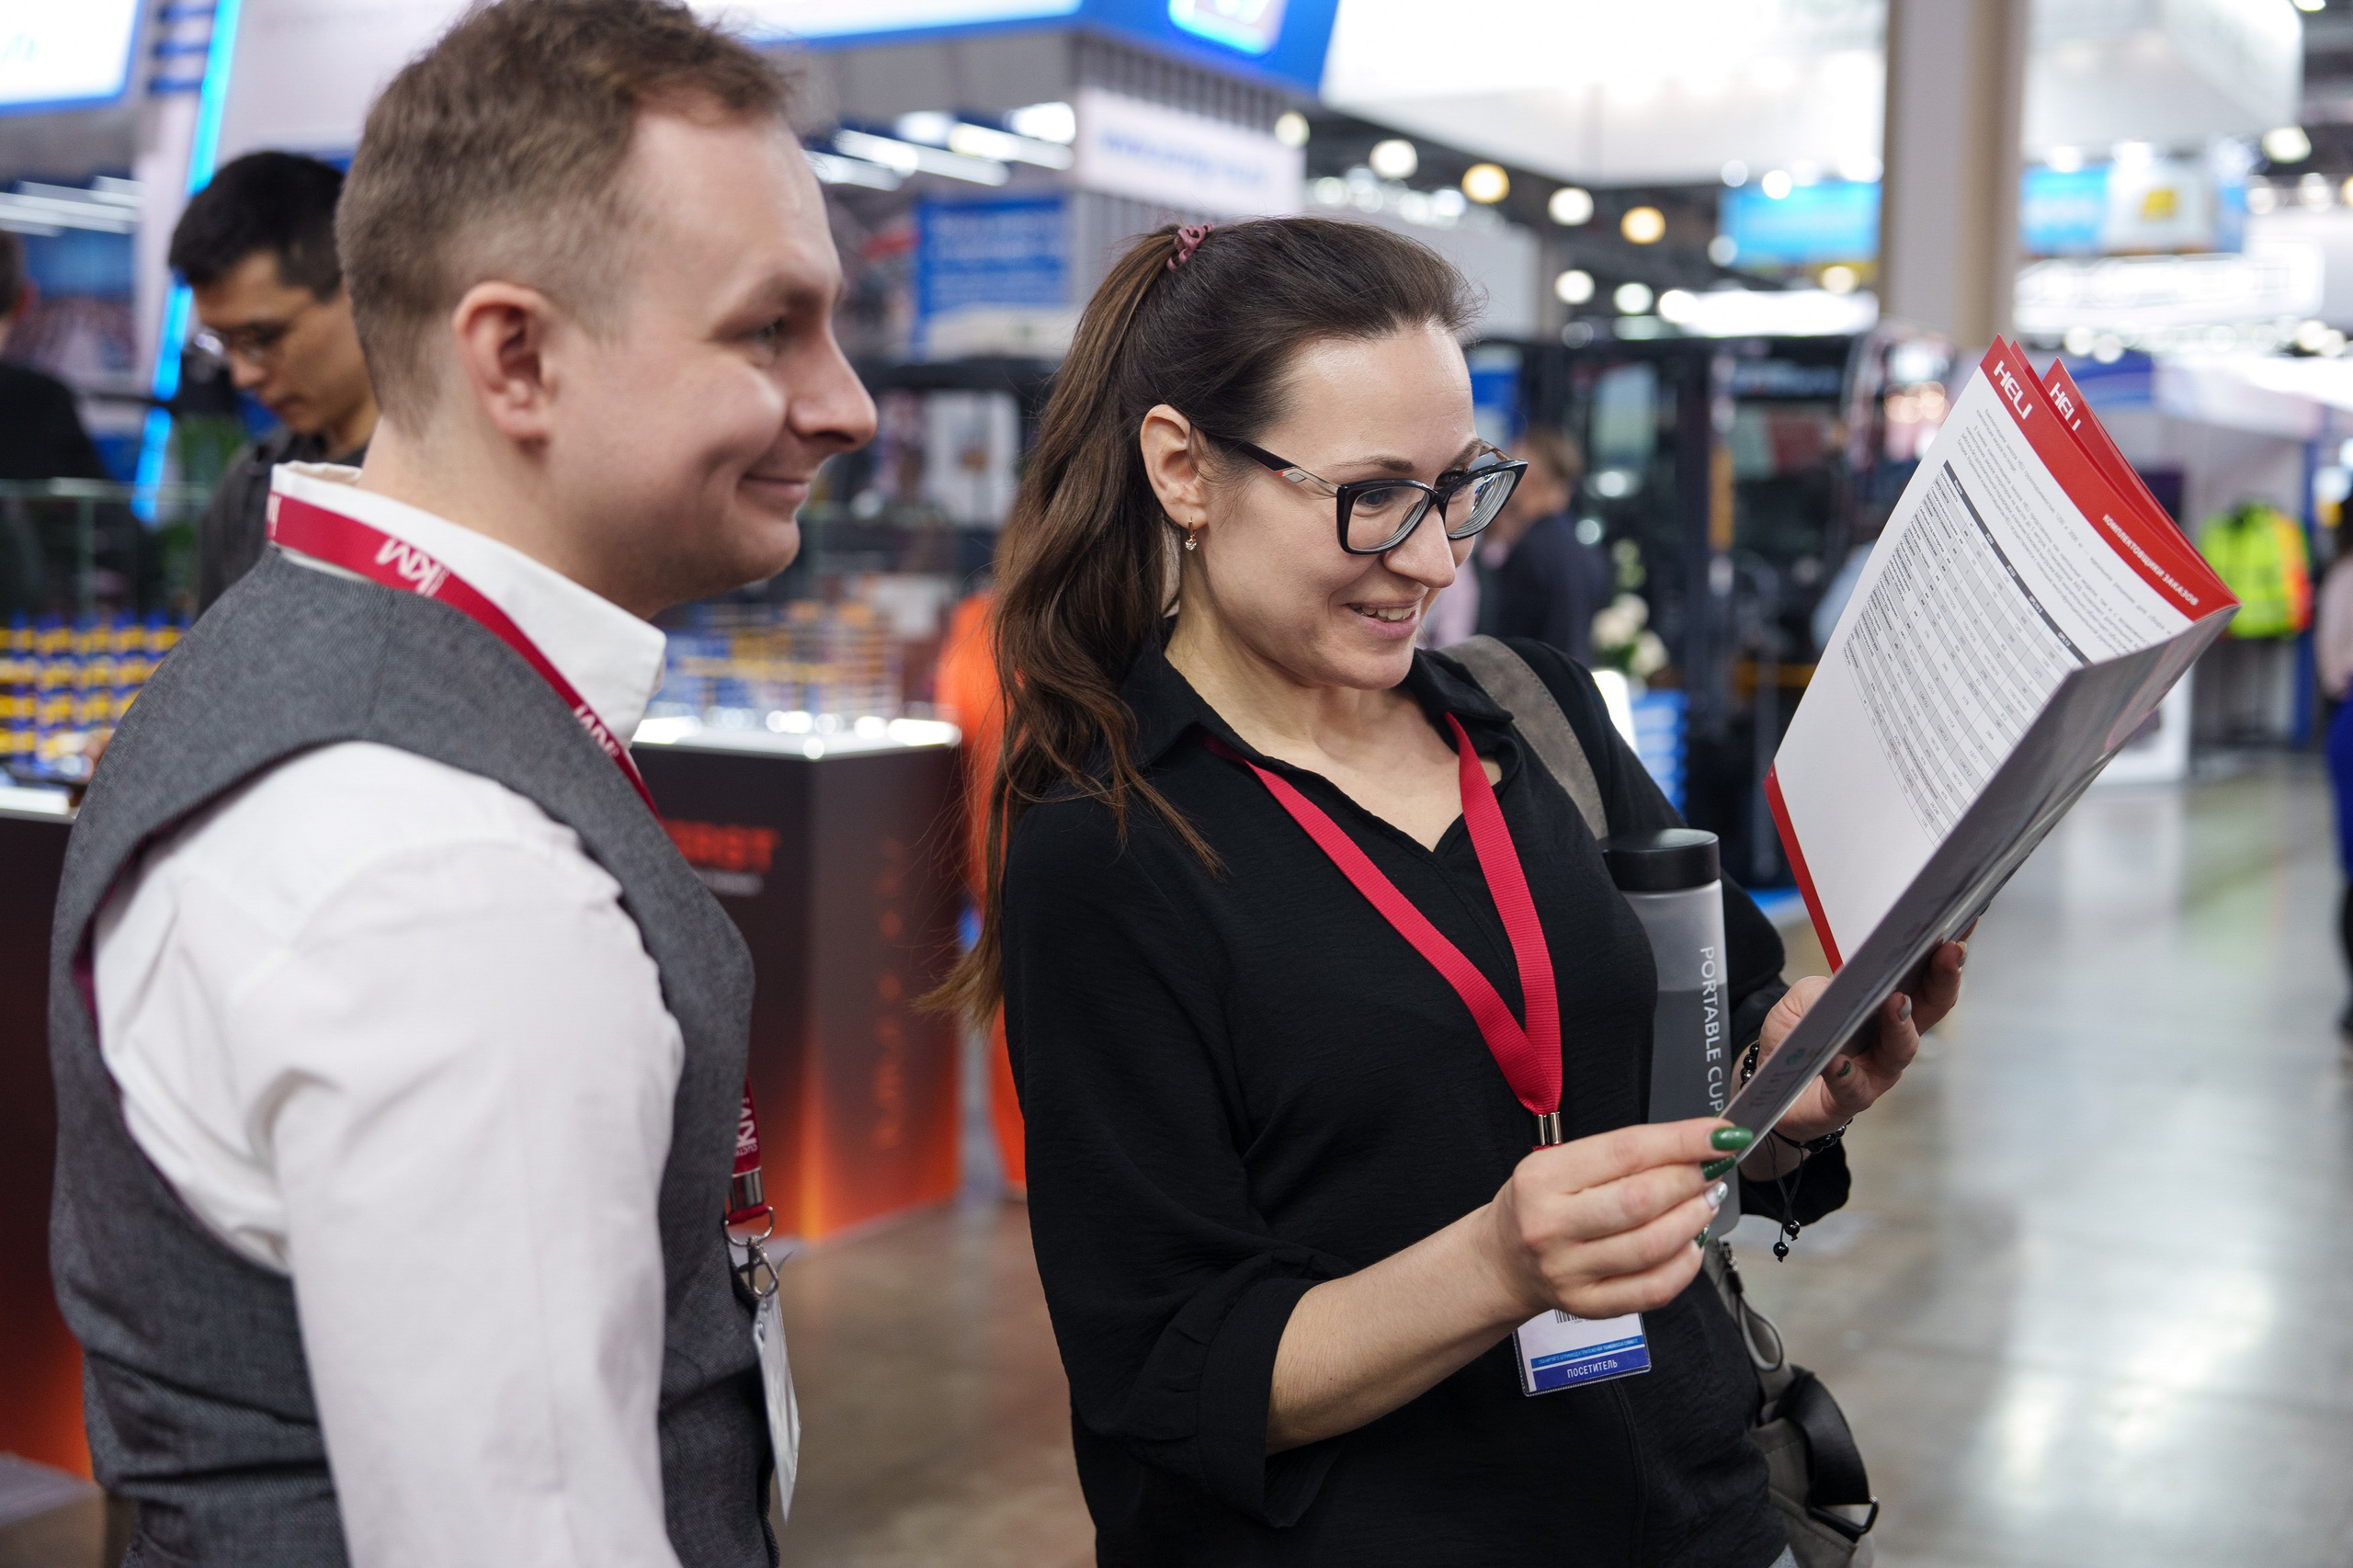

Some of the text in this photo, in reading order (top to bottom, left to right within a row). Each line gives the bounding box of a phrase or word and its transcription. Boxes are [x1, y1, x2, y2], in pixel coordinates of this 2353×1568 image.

[1993, 360, 2033, 419] HELI
[2102, 514, 2200, 606] КОМПЛЕКТОВЩИКИ ЗАКАЗОВ
[1700, 947, 1724, 1111] PORTABLE CUP
[1566, 1359, 1619, 1379] ПОСЕТИТЕЛЬ
